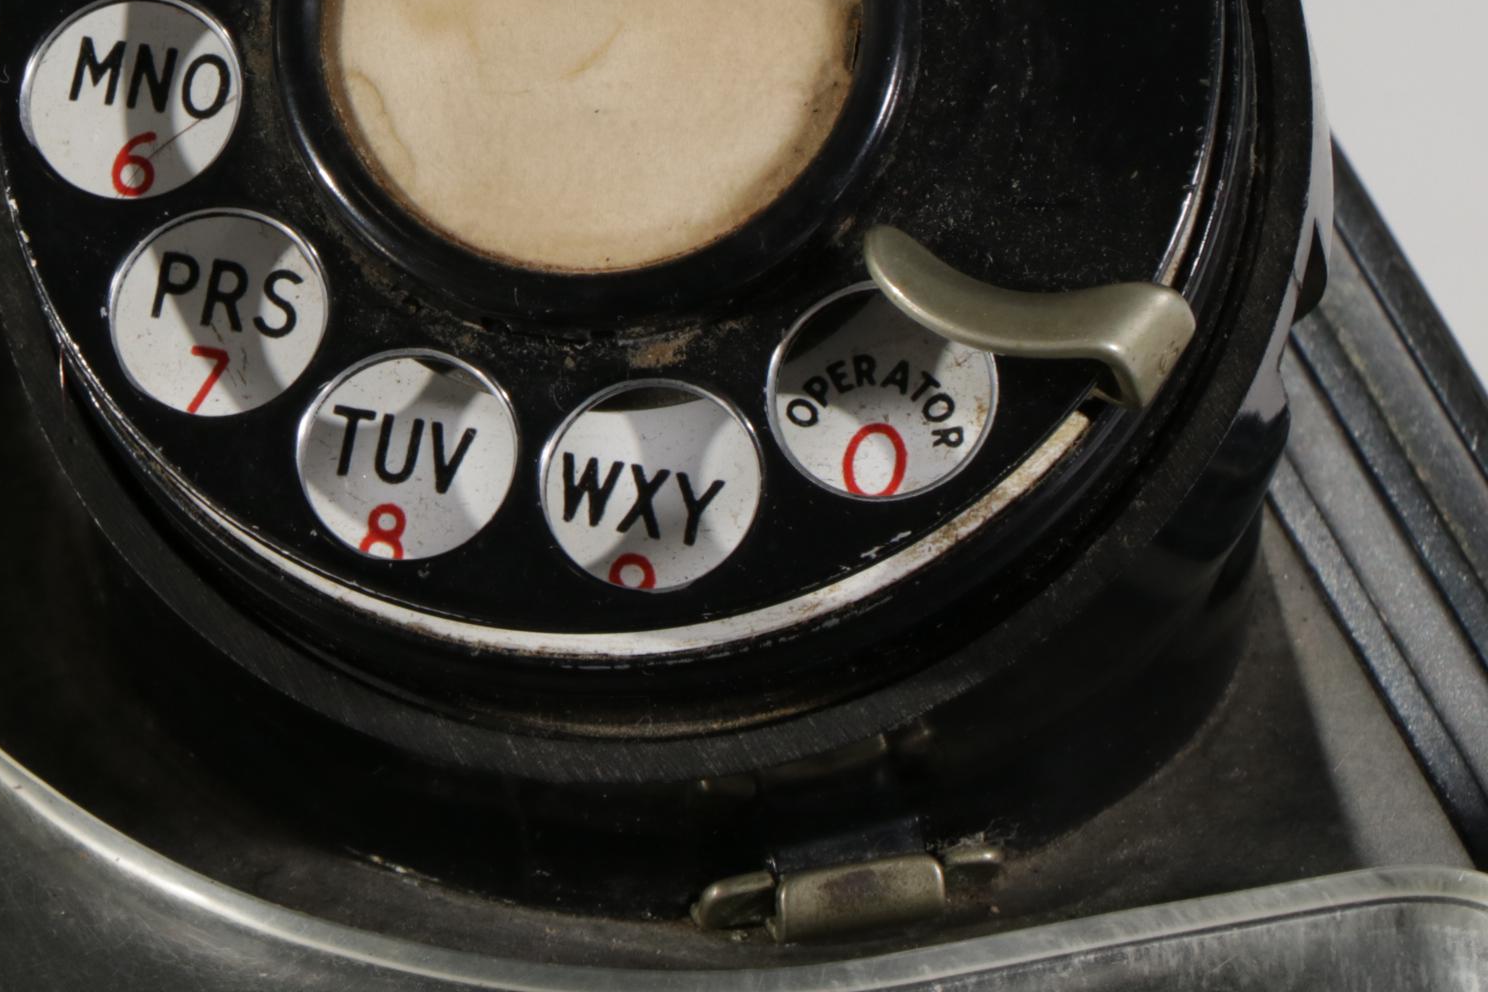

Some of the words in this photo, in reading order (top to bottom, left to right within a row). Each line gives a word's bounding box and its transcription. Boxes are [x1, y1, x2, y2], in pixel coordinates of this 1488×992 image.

[68, 36, 231, 119] MNO
[112, 131, 157, 197] 6
[151, 251, 304, 339] PRS
[187, 345, 229, 414] 7
[786, 354, 964, 448] OPERATOR
[333, 405, 477, 495] TUV
[359, 503, 406, 560] 8
[562, 451, 725, 546] WXY
